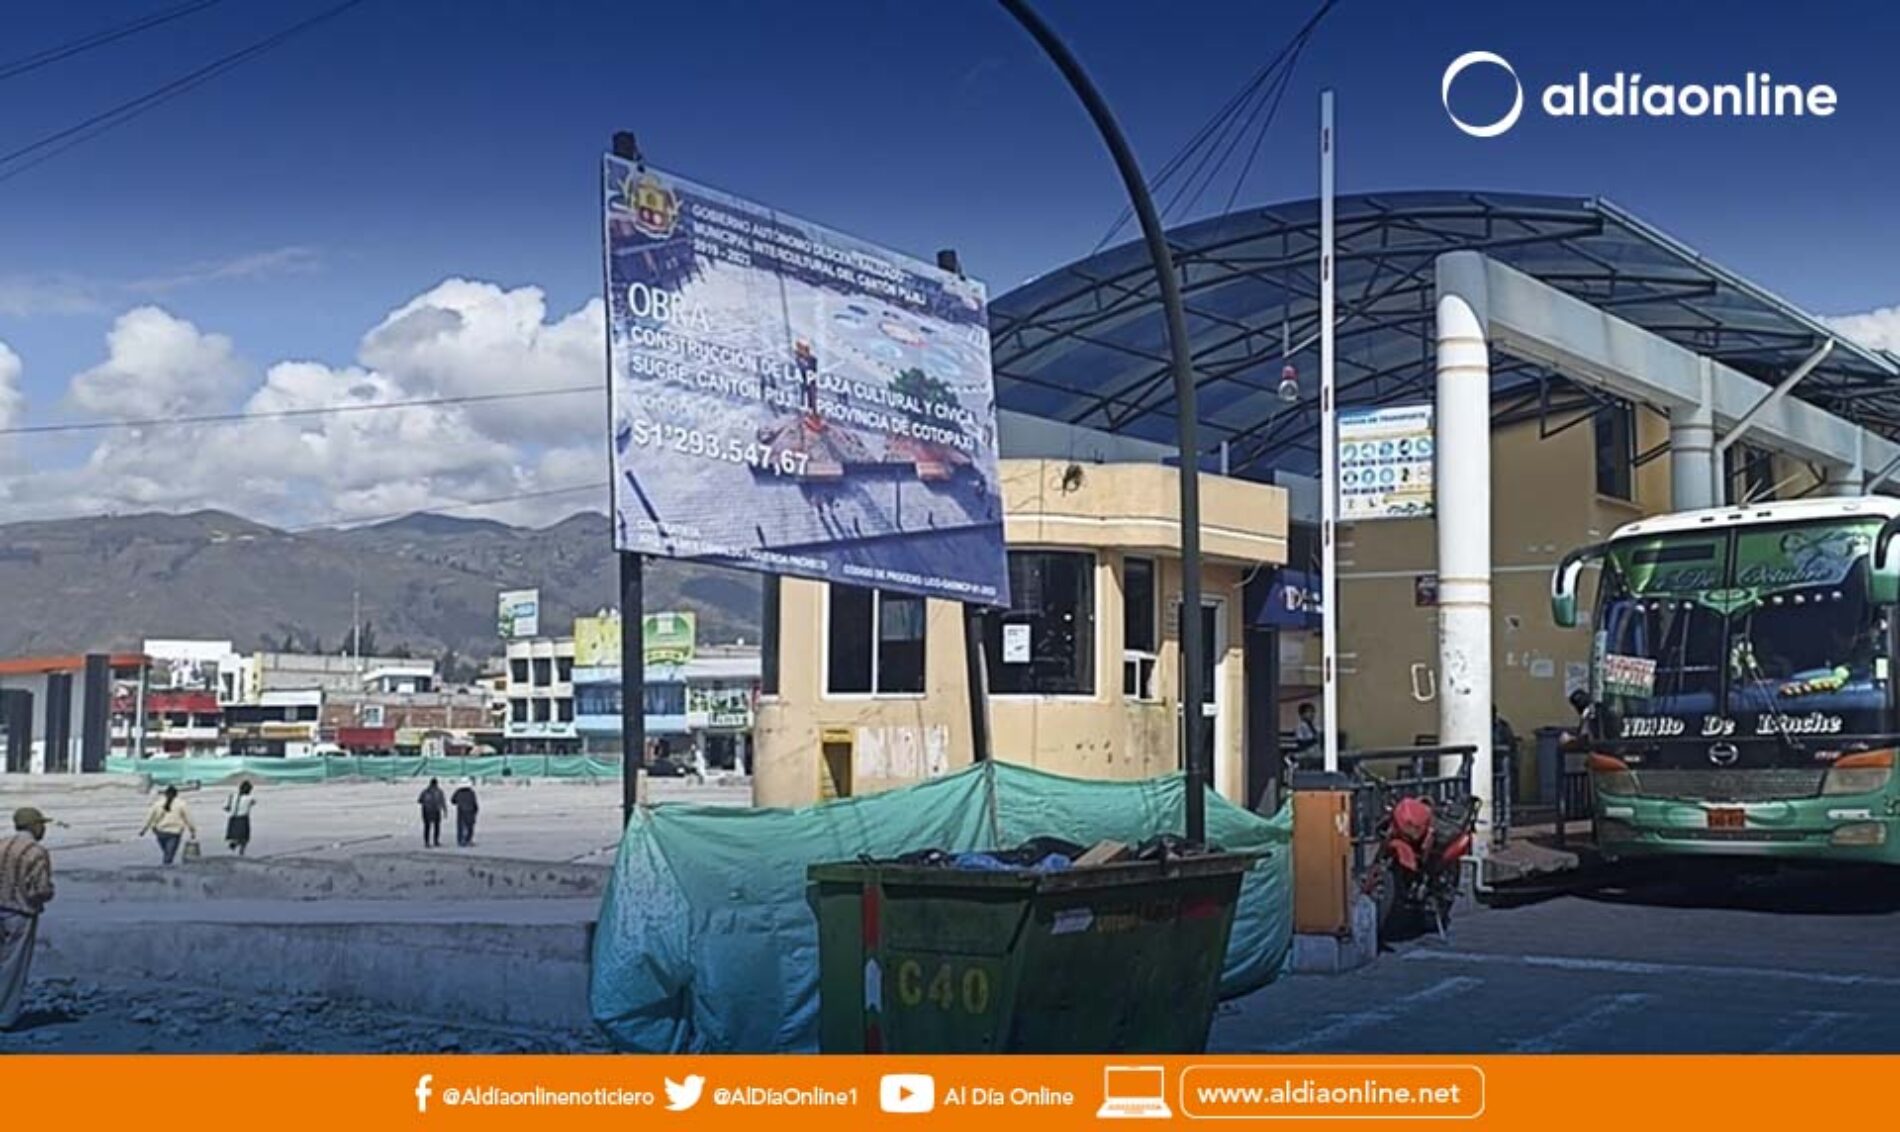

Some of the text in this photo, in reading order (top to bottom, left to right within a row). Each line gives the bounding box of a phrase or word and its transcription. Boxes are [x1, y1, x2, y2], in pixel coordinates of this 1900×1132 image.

[691, 203, 750, 232] GOBIERNO
[692, 220, 750, 249] MUNICIPAL
[753, 239, 835, 276] INTERCULTURAL
[837, 267, 856, 282] DEL
[693, 237, 720, 256] 2019
[628, 279, 710, 333] OBRA
[760, 358, 782, 377] DE
[784, 365, 804, 383] LA
[806, 369, 850, 394] PLAZA
[854, 381, 921, 412] CULTURAL
[923, 400, 933, 415] Y
[816, 398, 888, 430] PROVINCIA
[891, 417, 910, 435] DE
[911, 422, 974, 450] COTOPAXI
